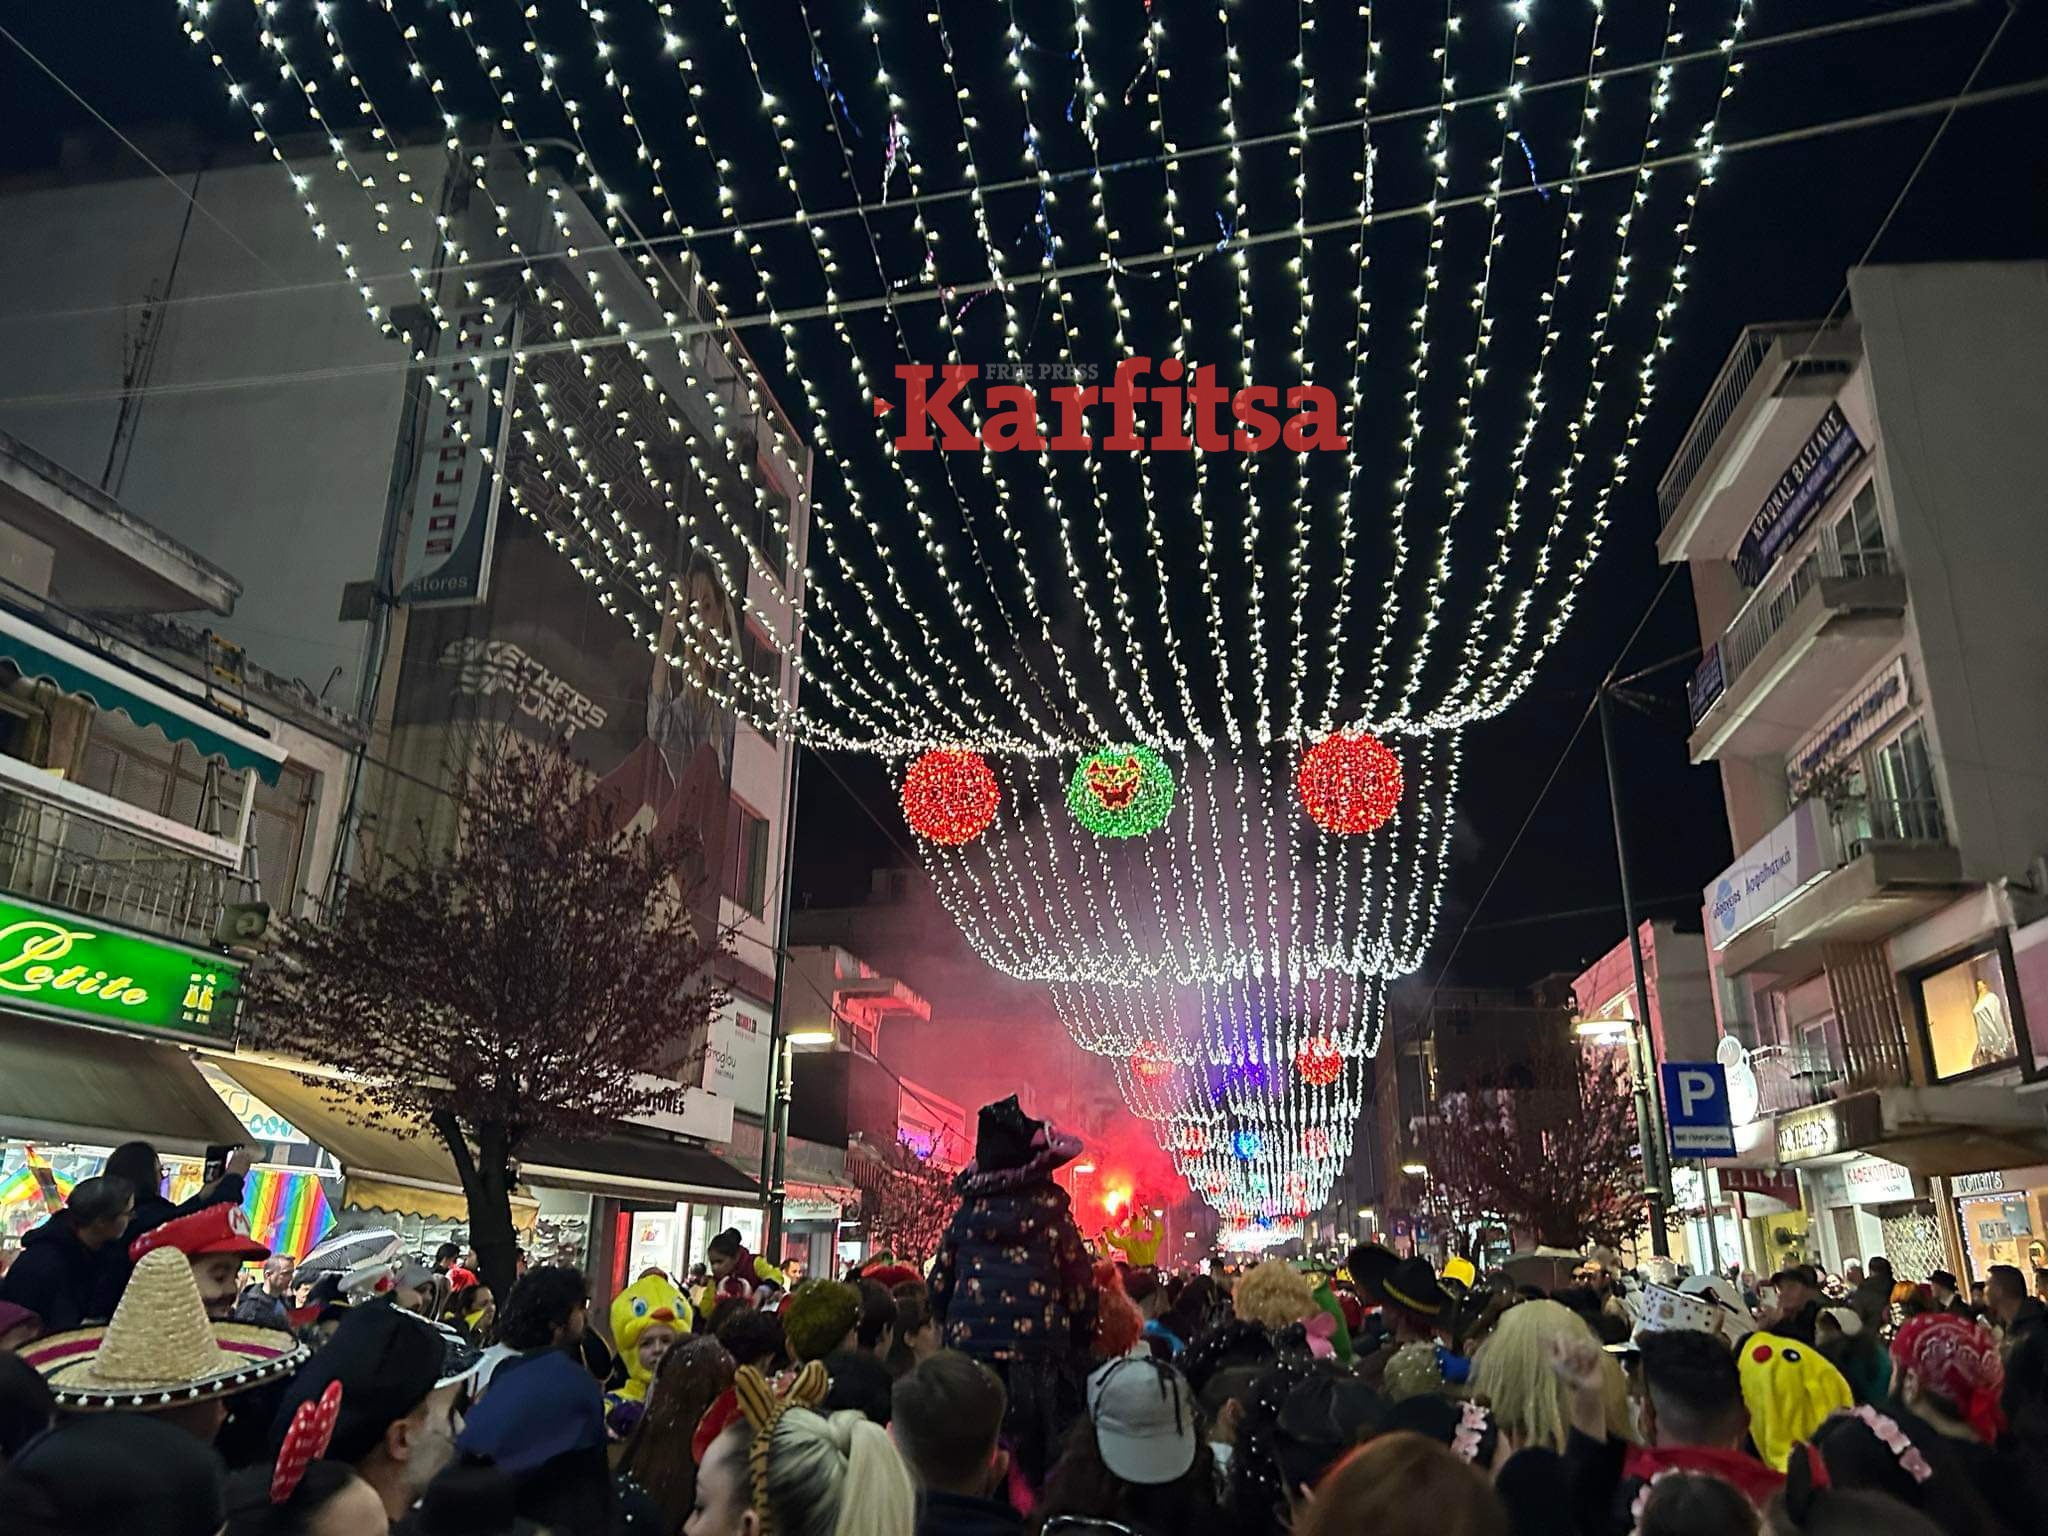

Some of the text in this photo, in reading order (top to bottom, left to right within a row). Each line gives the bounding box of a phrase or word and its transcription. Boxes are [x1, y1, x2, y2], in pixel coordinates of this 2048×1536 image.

[1791, 409, 1842, 484] ΒΑΣΙΛΗΣ
[412, 574, 469, 594] stores
[439, 636, 608, 729] SKECHERS
[1678, 1071, 1716, 1117] P
